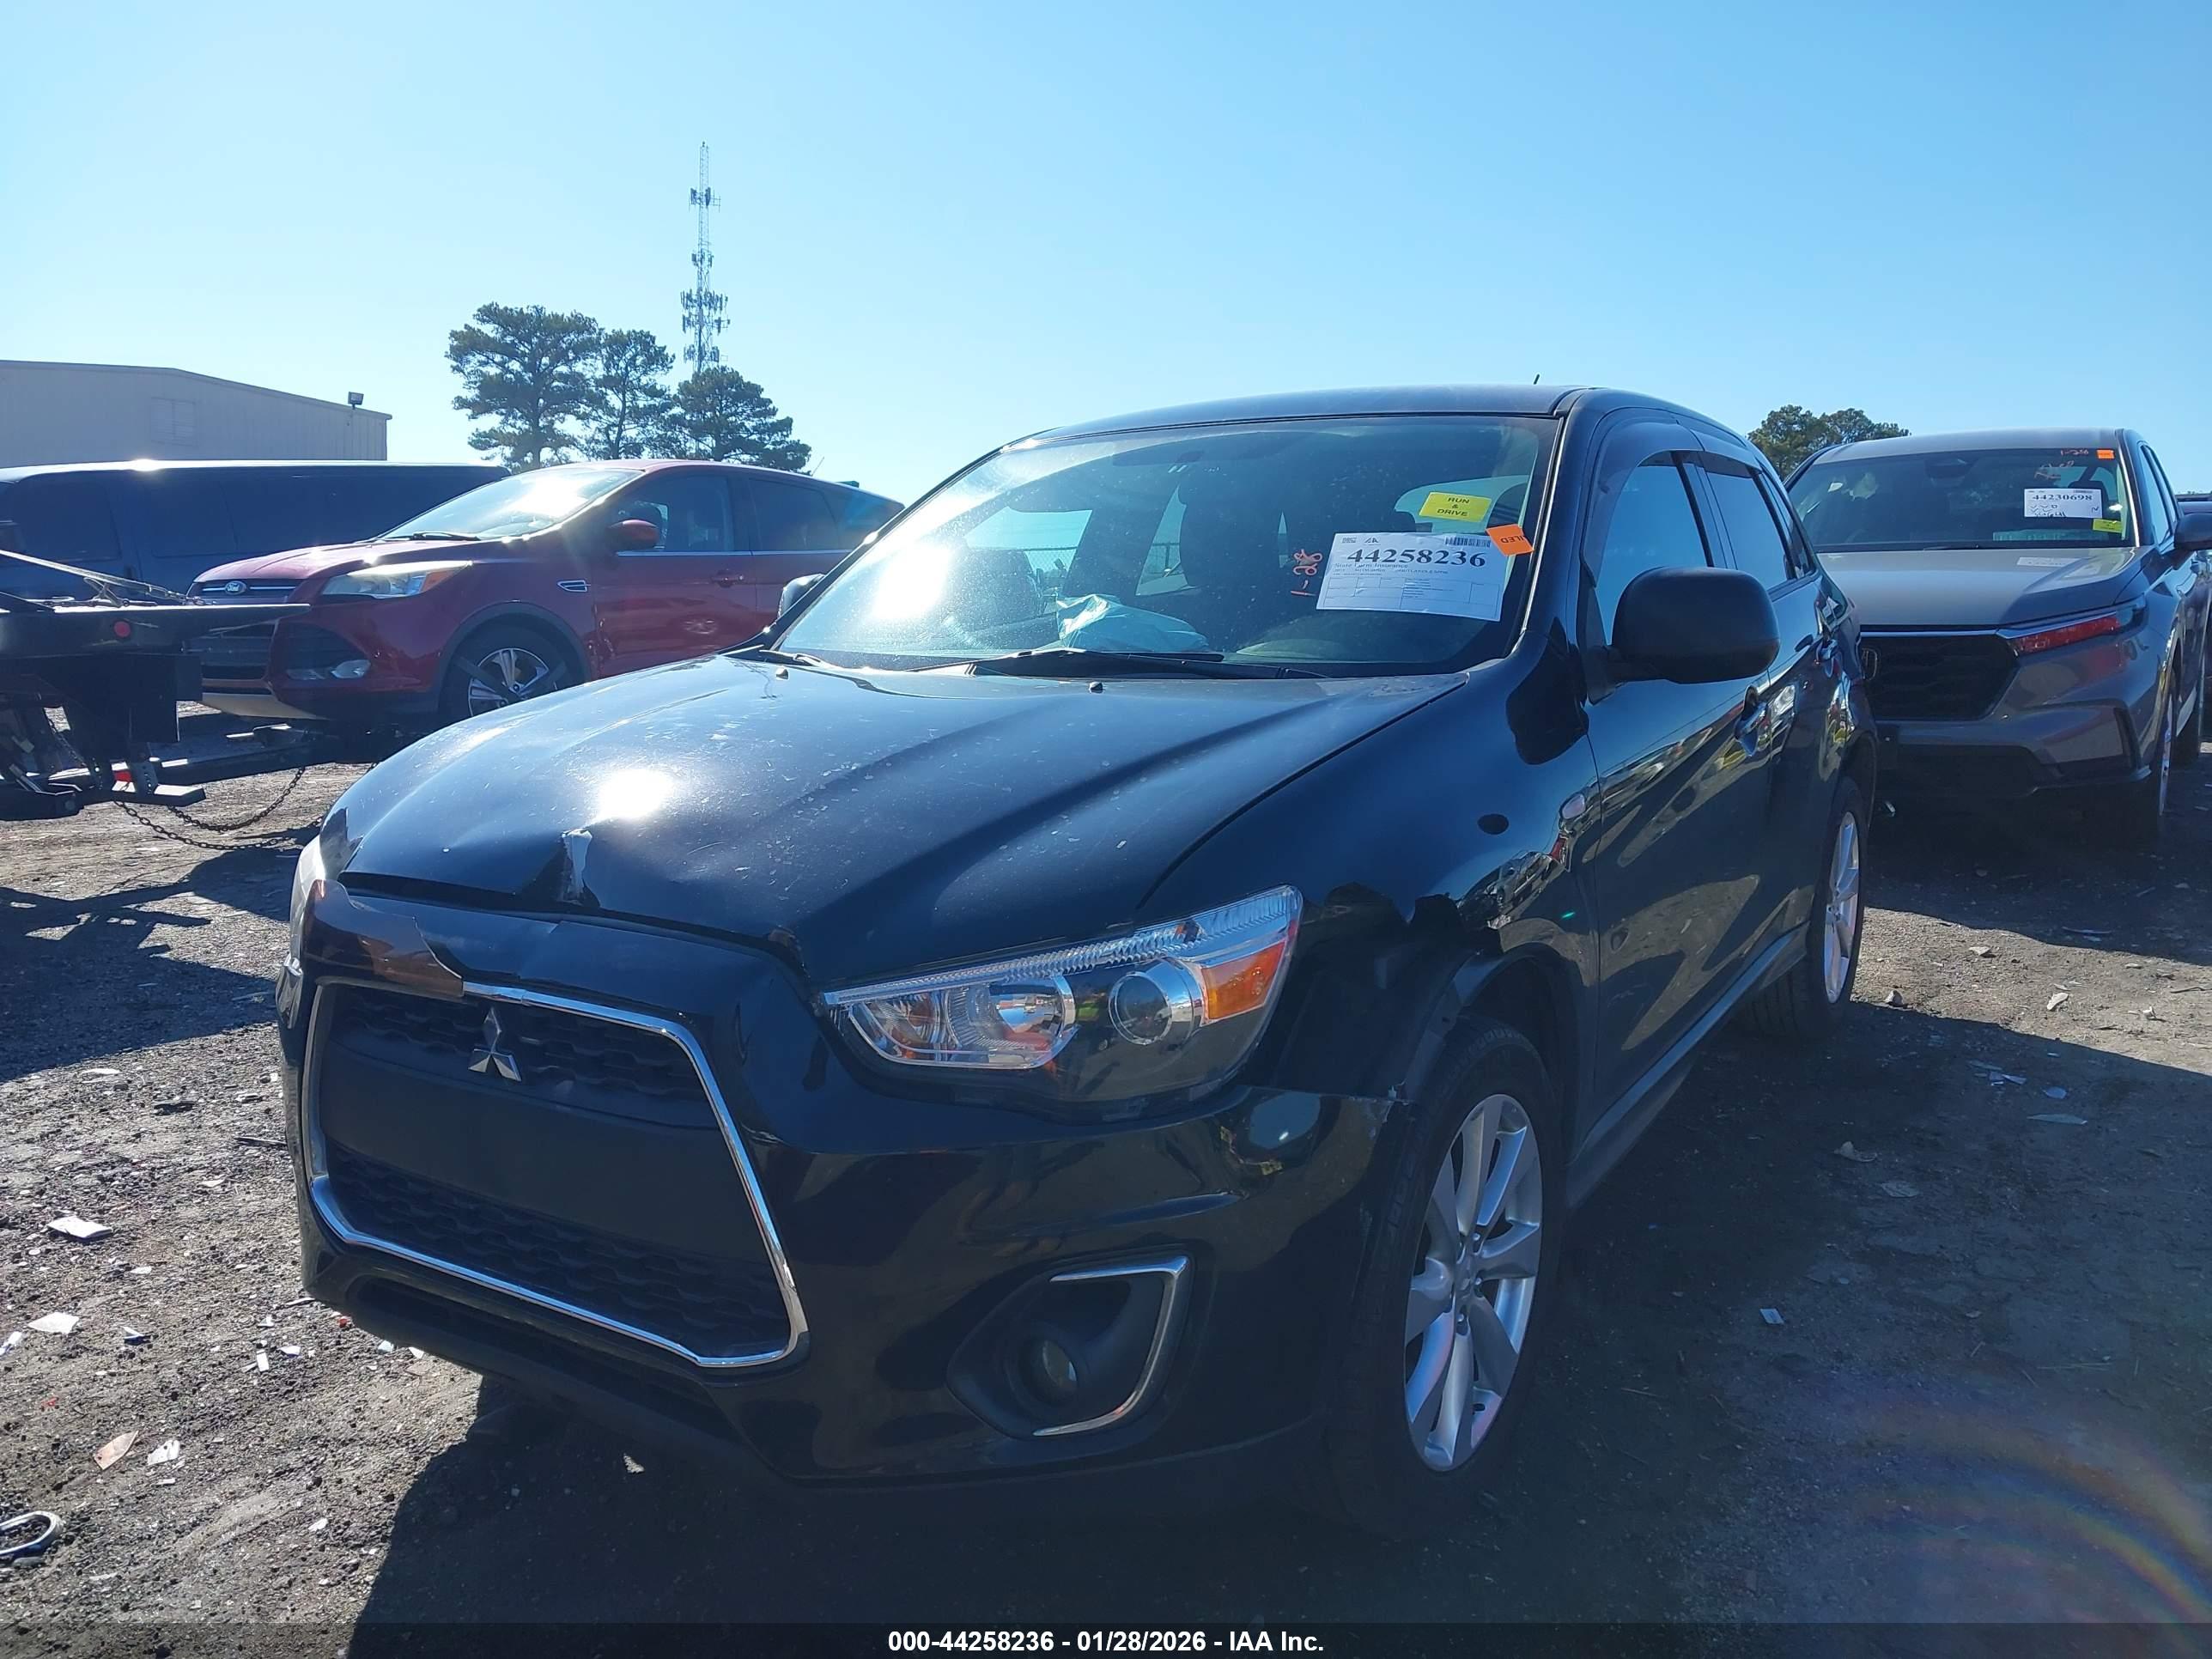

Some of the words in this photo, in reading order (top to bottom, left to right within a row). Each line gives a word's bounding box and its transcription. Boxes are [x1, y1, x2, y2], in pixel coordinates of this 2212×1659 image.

[1437, 508, 1468, 517] DRIVE
[1500, 535, 1525, 544] ILED
[1346, 549, 1486, 567] 44258236
